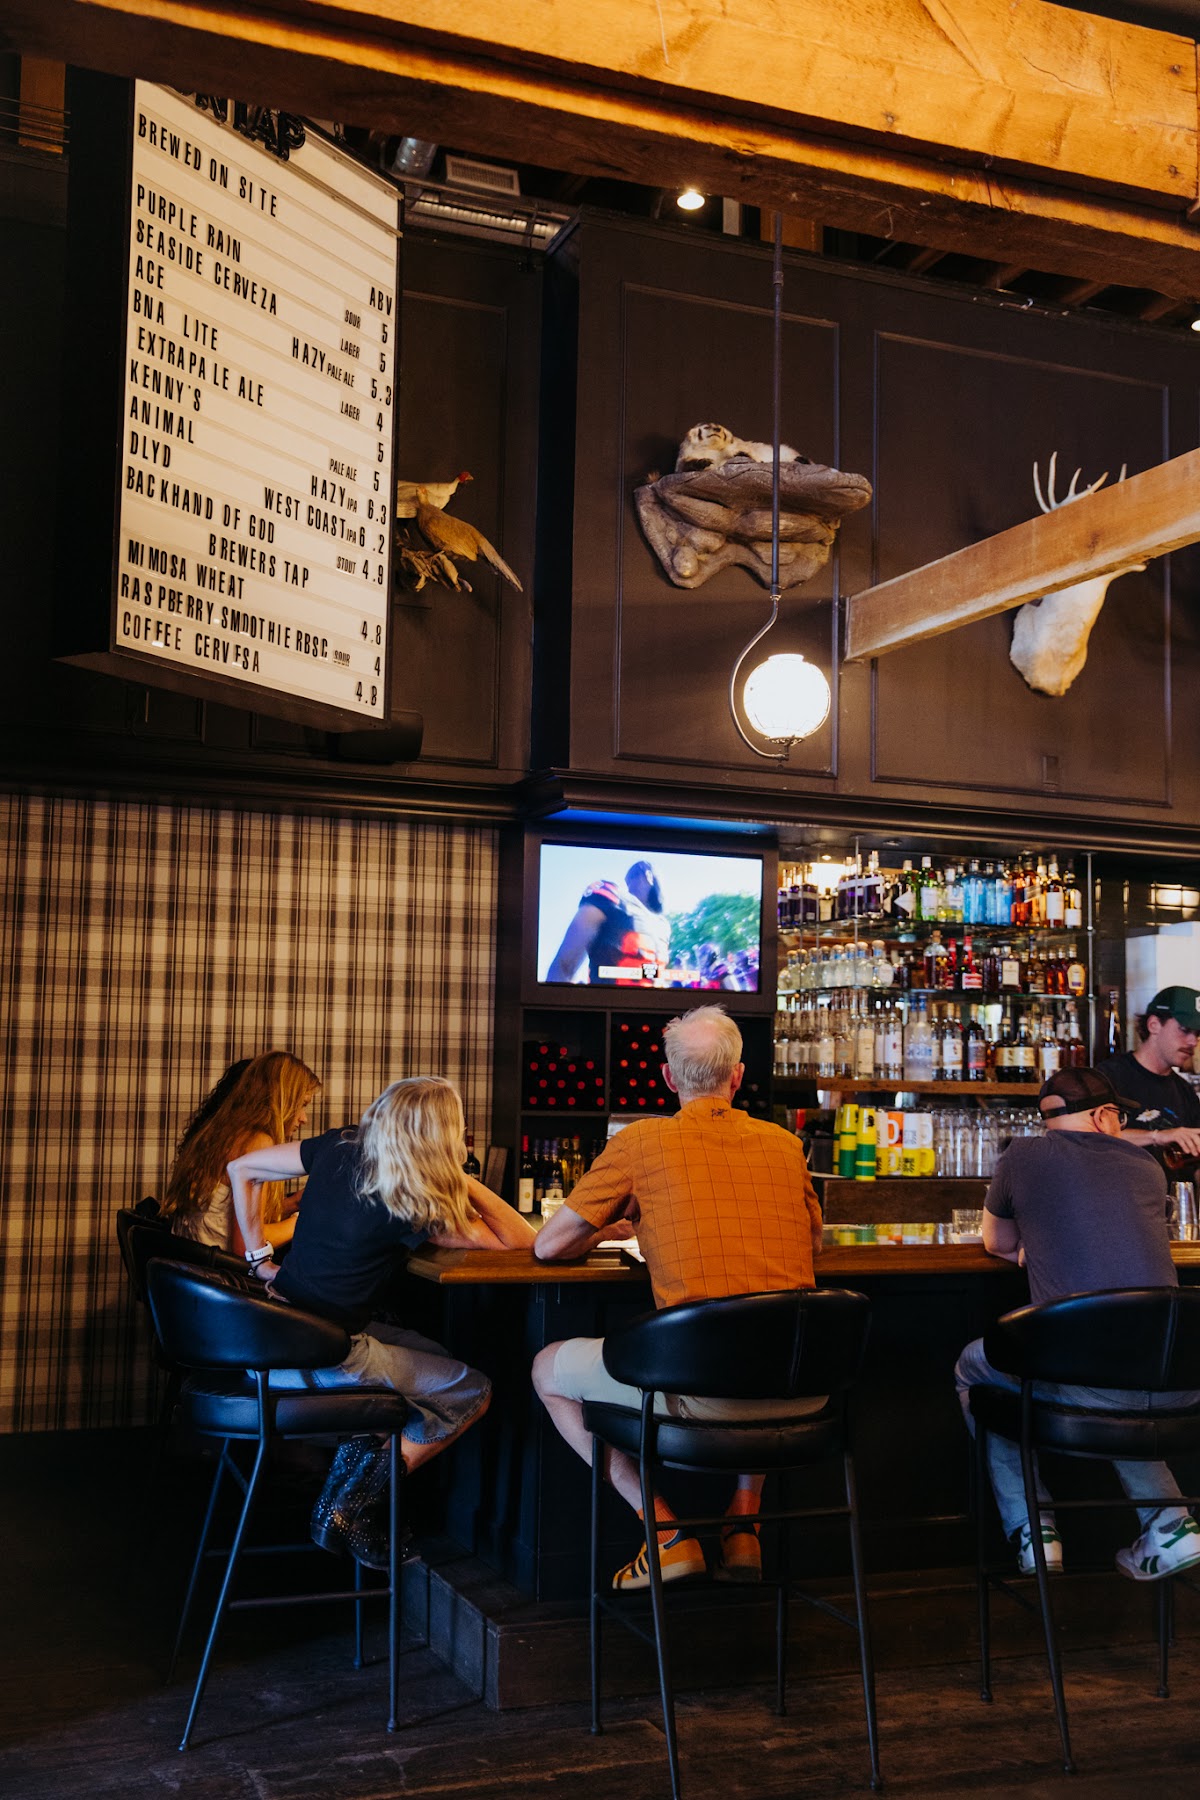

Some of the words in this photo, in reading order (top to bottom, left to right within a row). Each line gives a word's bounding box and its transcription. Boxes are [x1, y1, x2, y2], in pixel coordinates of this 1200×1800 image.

[138, 113, 202, 171] BREWED
[209, 158, 228, 189] ON
[239, 176, 277, 218] SITE
[136, 218, 203, 275] SEASIDE
[214, 262, 277, 316] CERVEZA
[340, 338, 361, 360] LAGER
[379, 352, 386, 373] 5
[137, 183, 198, 238] PURPLE
[207, 223, 241, 263] RAIN
[381, 323, 389, 344] 5
[369, 286, 393, 316] ABV
[133, 288, 164, 326] BNA
[183, 314, 218, 351] LITE
[340, 400, 361, 421] LAGER
[376, 412, 383, 432] 4
[135, 254, 164, 289] ACE
[292, 336, 326, 372] HAZY
[326, 362, 342, 381] PALE
[343, 371, 355, 388] ALE
[129, 395, 194, 444] ANIMAL
[311, 474, 346, 507] HAZY
[347, 497, 358, 513] IPA
[367, 498, 387, 525] 6.3
[130, 358, 201, 412] KENNY'S
[329, 458, 345, 476] PALE
[345, 465, 357, 482] ALE
[373, 470, 380, 492] 5
[238, 376, 264, 407] ALE
[377, 442, 384, 463] 5
[126, 465, 213, 520] BACKHAND
[223, 504, 241, 530] OF
[249, 514, 275, 544] GOD
[336, 555, 356, 575] STOUT
[129, 430, 171, 468] DLYD
[264, 486, 300, 521] WEST
[307, 504, 346, 539] COAST
[346, 528, 357, 544] IPA
[128, 539, 187, 582] MIMOSA
[196, 563, 245, 600] WHEAT
[361, 620, 382, 645] 4.8
[208, 533, 276, 578] BREWERS
[284, 560, 309, 588] TAP
[121, 573, 214, 625] RASPBERRY
[221, 606, 291, 649] SMOOTHIE
[374, 656, 381, 676] 4
[122, 611, 182, 651] COFFEE
[355, 681, 378, 706] 4.8
